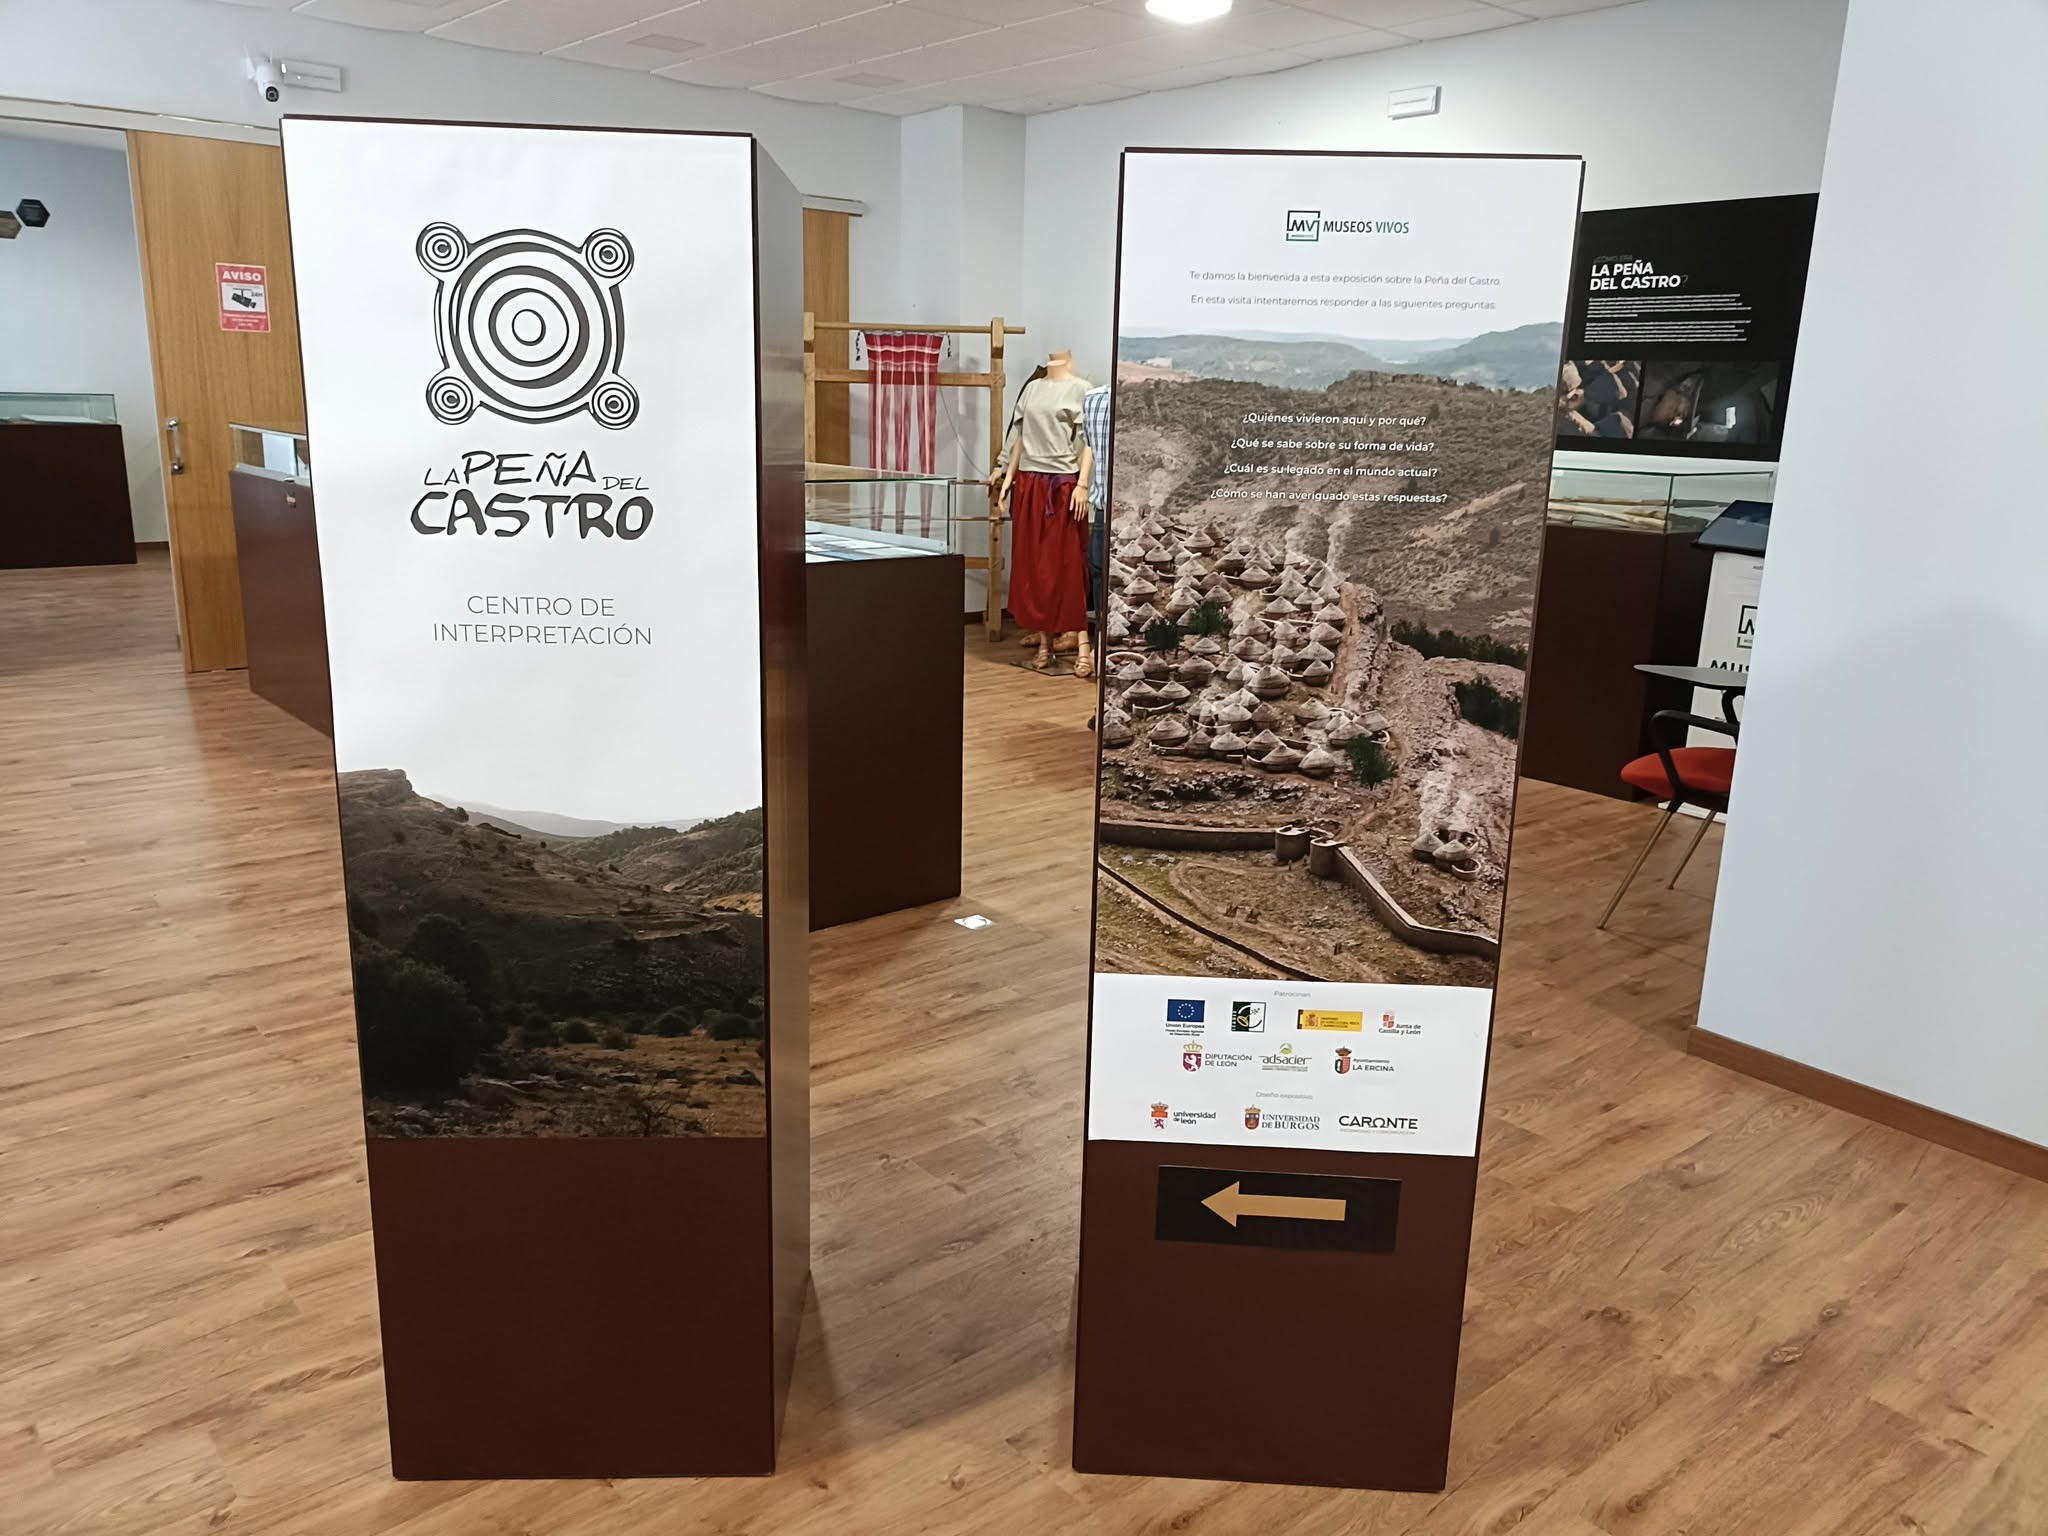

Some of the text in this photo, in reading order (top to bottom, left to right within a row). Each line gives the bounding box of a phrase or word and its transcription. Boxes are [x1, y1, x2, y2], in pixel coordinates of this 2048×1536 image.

[1291, 220, 1409, 234] MV MUSEOS VIVOS
[1591, 259, 1653, 277] LA PEÑA
[223, 271, 261, 281] AVISO
[1190, 271, 1200, 279] Te
[1202, 272, 1235, 280] damos
[1237, 272, 1245, 280] la
[1248, 272, 1300, 281] bienvenida
[1310, 274, 1330, 282] esta
[1332, 274, 1382, 284] exposición
[1385, 275, 1411, 283] sobre
[1414, 275, 1421, 284] la
[1424, 275, 1449, 284] Peña
[1451, 276, 1466, 284] del
[1590, 277, 1618, 290] DEL
[1191, 294, 1203, 303] En
[1206, 296, 1225, 304] esta
[1228, 296, 1251, 304] visita
[1254, 296, 1317, 305] intentaremos
[1320, 298, 1368, 307] responder
[1378, 298, 1391, 307] las
[1394, 300, 1442, 309] siguientes
[1242, 412, 1425, 426] ¿Quiénes vivieron aquí y por qué?
[1231, 438, 1258, 448] ¿Qué
[1277, 439, 1302, 448] sabe
[1305, 440, 1335, 449] sobre
[1354, 440, 1385, 450] forma
[1389, 442, 1402, 450] de
[1406, 441, 1433, 451] vida?
[424, 450, 649, 490] LA PEÑA DEL
[1224, 463, 1253, 474] ¿Cuál
[1271, 466, 1283, 474] su
[1286, 464, 1324, 477] legado
[1327, 467, 1340, 475] en
[1343, 465, 1353, 475] el
[1356, 466, 1394, 476] mundo
[1398, 467, 1437, 477] actual?
[1266, 489, 1285, 499] han
[1289, 490, 1349, 503] averiguado
[1352, 492, 1380, 502] estas
[1383, 493, 1447, 504] respuestas?
[410, 489, 653, 540] CASTRO
[467, 595, 614, 616] CENTRO DE
[433, 623, 652, 645] INTERPRETACIÓN
[1205, 1052, 1252, 1061] DIPUTACIÓN
[1173, 1111, 1216, 1120] universidad
[1180, 1117, 1196, 1125] león
[1262, 1113, 1320, 1123] UNIVERSIDAD
[1274, 1122, 1320, 1131] BURGOS
